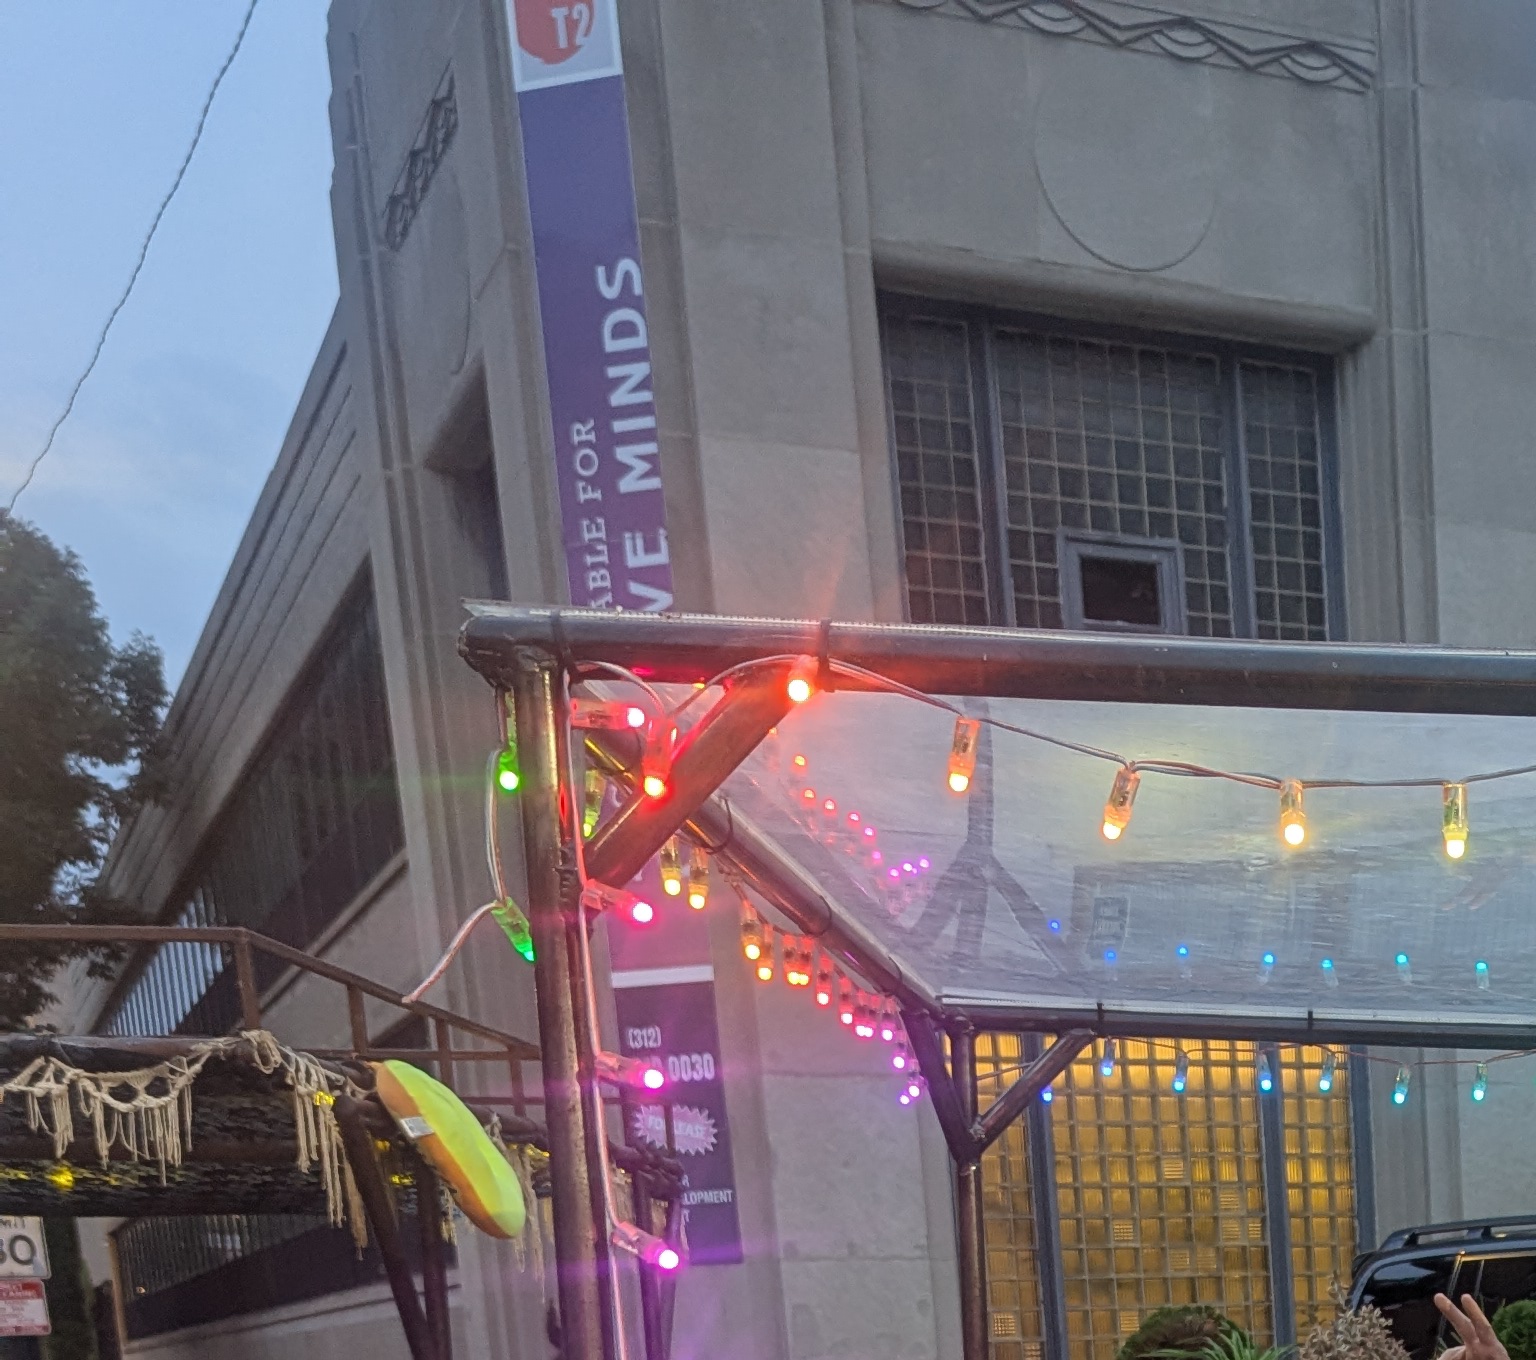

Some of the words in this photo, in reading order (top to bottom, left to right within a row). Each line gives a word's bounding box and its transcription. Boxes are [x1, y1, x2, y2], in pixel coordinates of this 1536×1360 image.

[597, 258, 662, 493] MINDS
[573, 418, 602, 504] FOR
[628, 1025, 662, 1048] (312)
